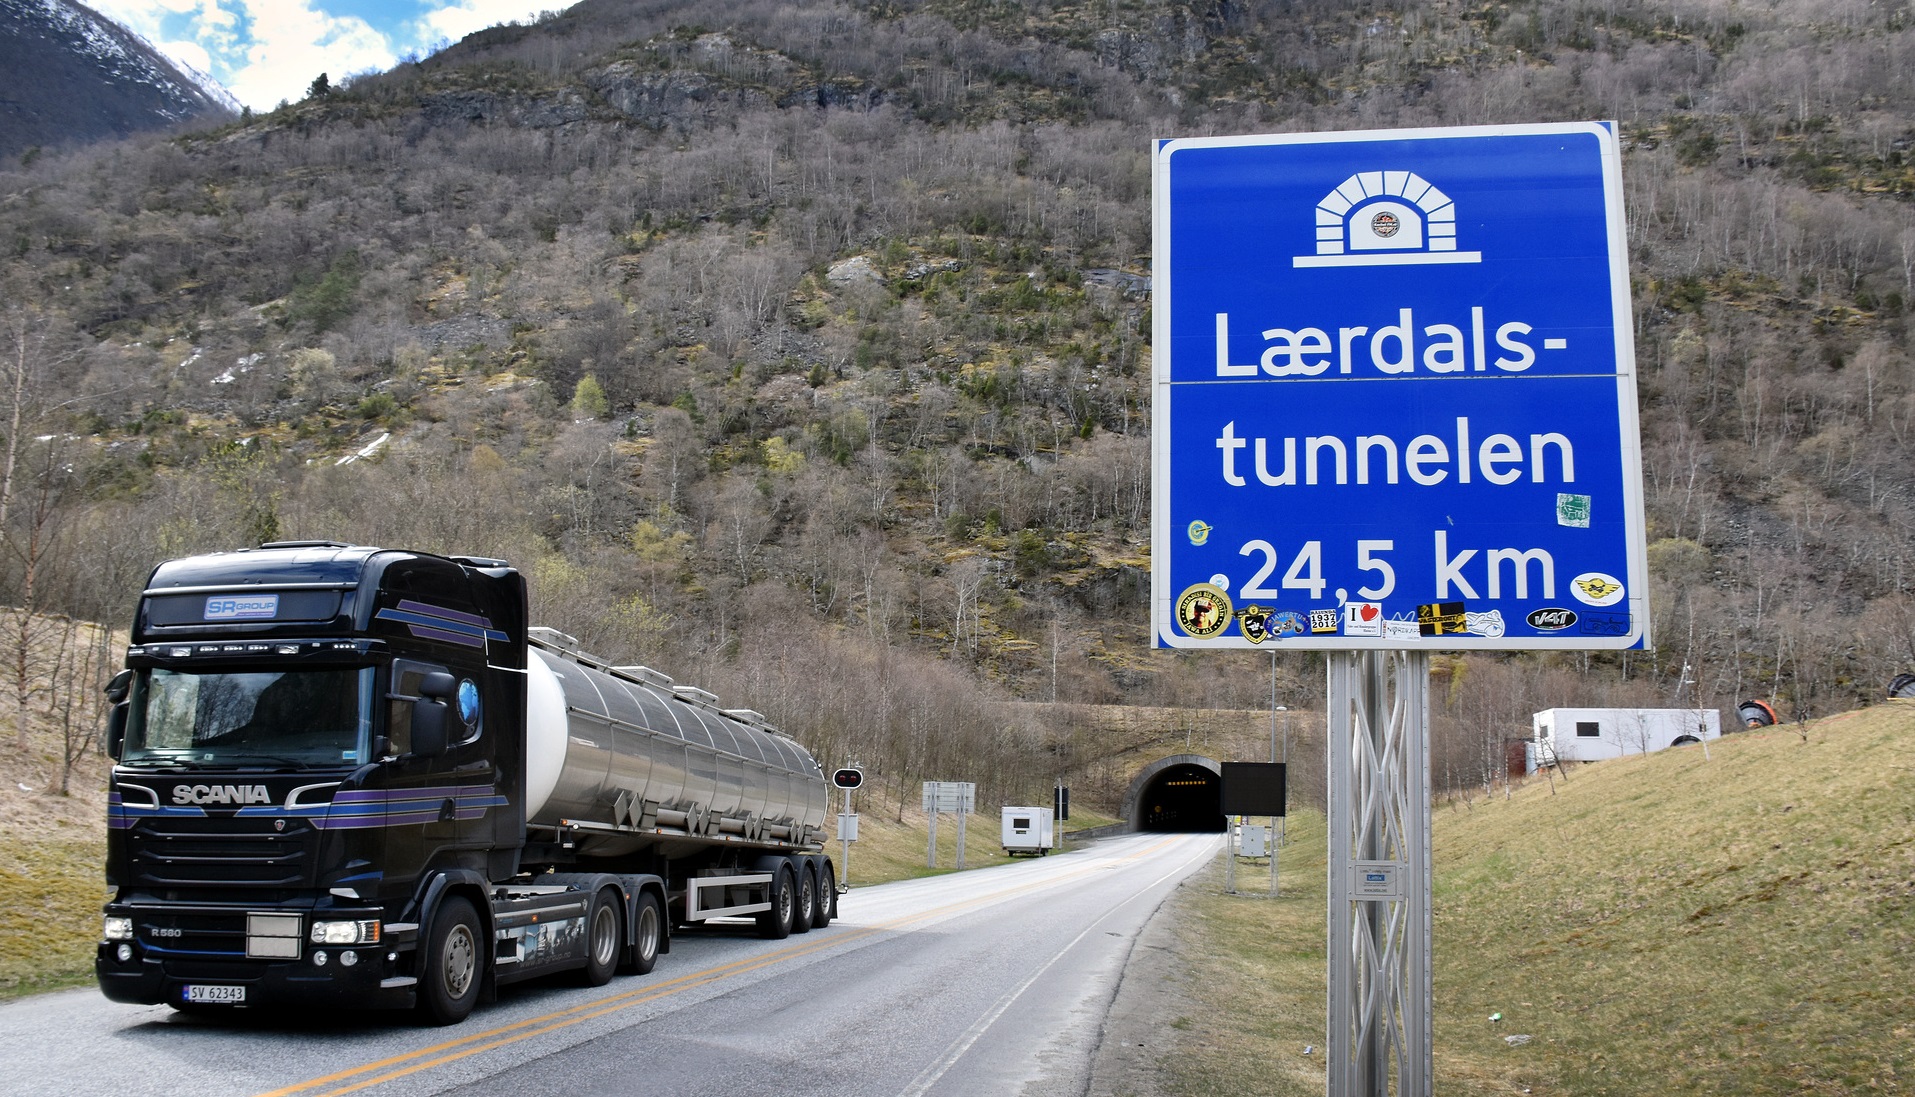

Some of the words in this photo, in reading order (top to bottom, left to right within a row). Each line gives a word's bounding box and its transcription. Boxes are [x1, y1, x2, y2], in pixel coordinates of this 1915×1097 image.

[1216, 307, 1567, 376] Lærdals-
[1216, 417, 1574, 486] tunnelen
[1239, 539, 1396, 608] 24,5
[1435, 531, 1554, 598] km
[1311, 614, 1336, 622] 1937
[1351, 608, 1356, 621] I
[1312, 620, 1336, 629] 2012
[172, 784, 271, 804] SCANIA
[151, 928, 160, 937] R
[160, 928, 182, 937] 580
[191, 986, 205, 999] SV
[208, 987, 243, 1000] 62343
